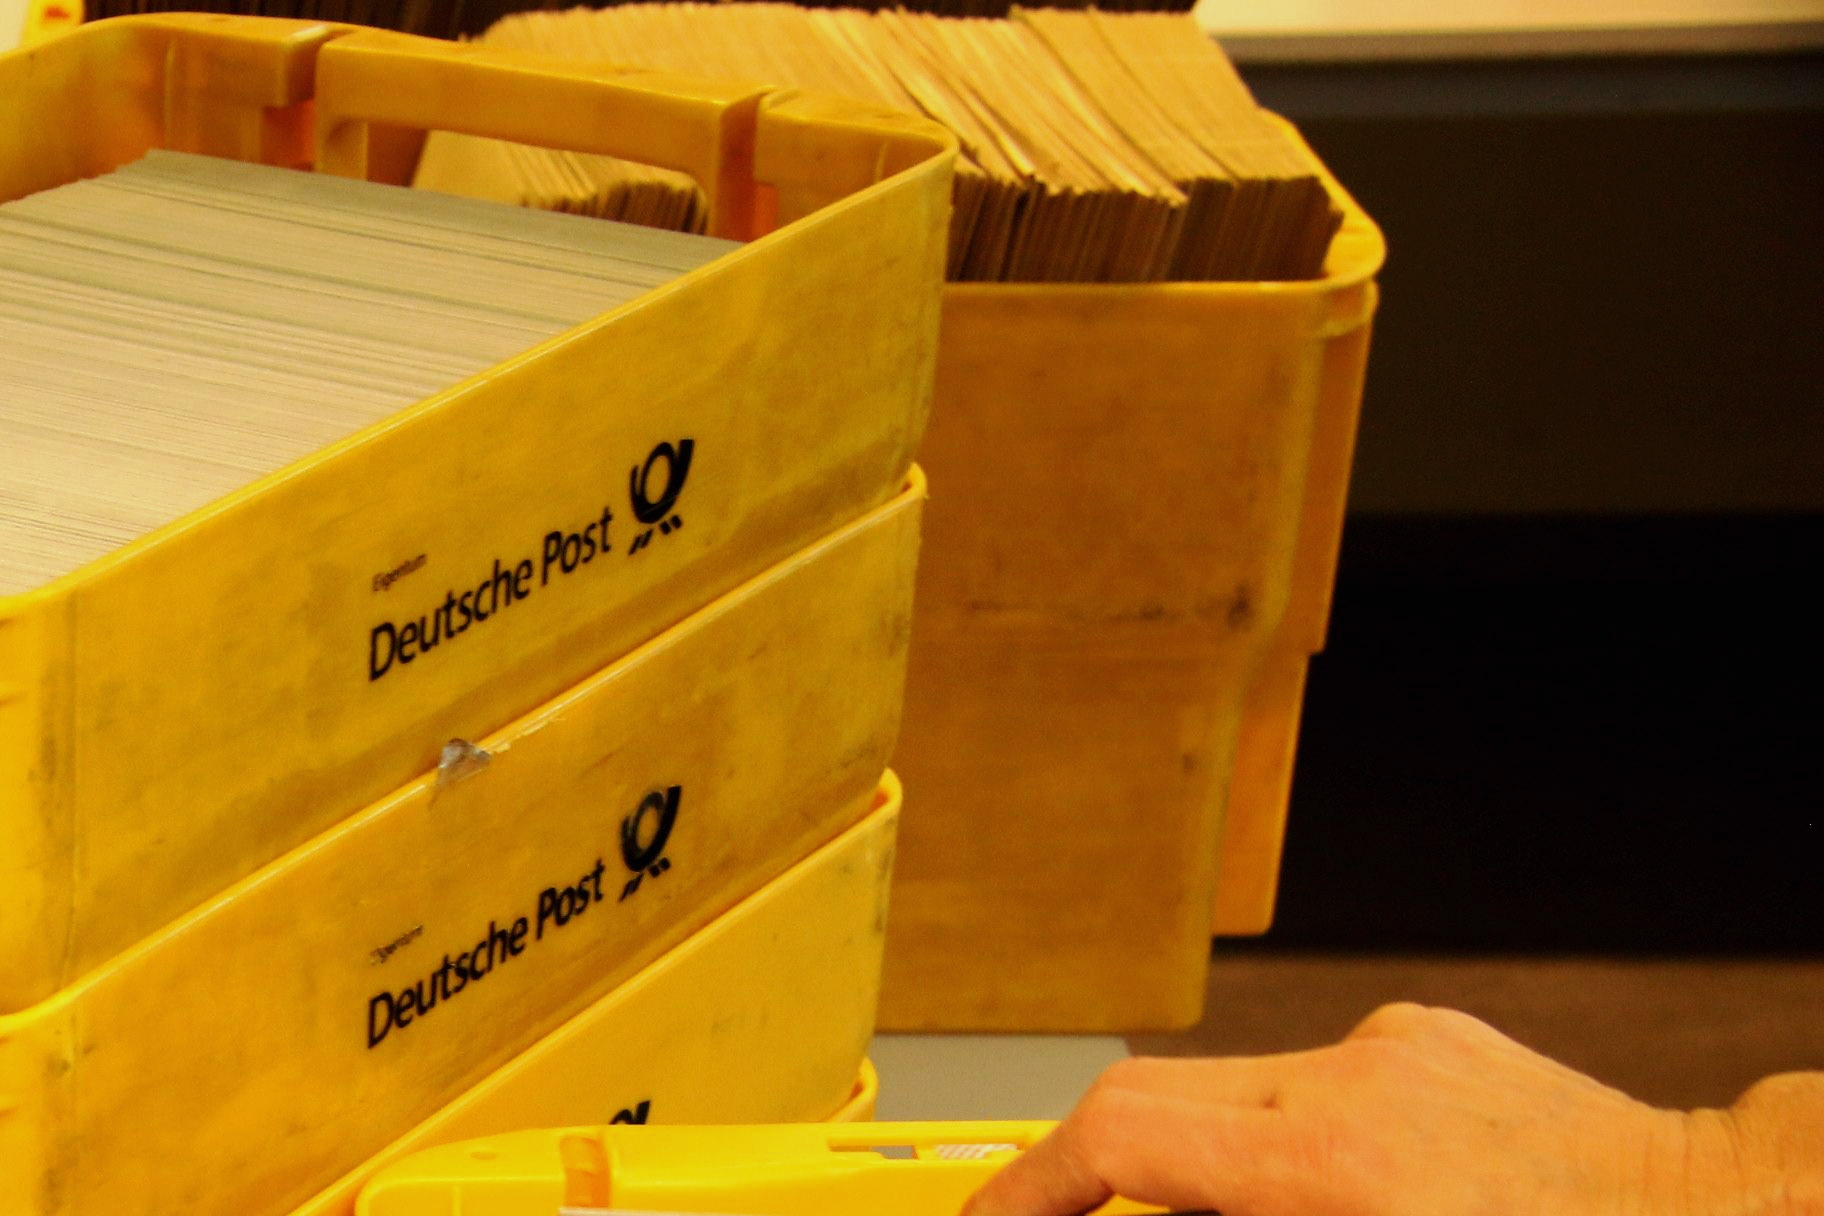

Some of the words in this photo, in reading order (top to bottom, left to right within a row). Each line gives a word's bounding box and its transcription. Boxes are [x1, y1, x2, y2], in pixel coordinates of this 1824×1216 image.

[368, 559, 533, 682] Deutsche
[541, 506, 613, 586] Post
[367, 917, 528, 1049] Deutsche
[536, 858, 605, 940] Post
